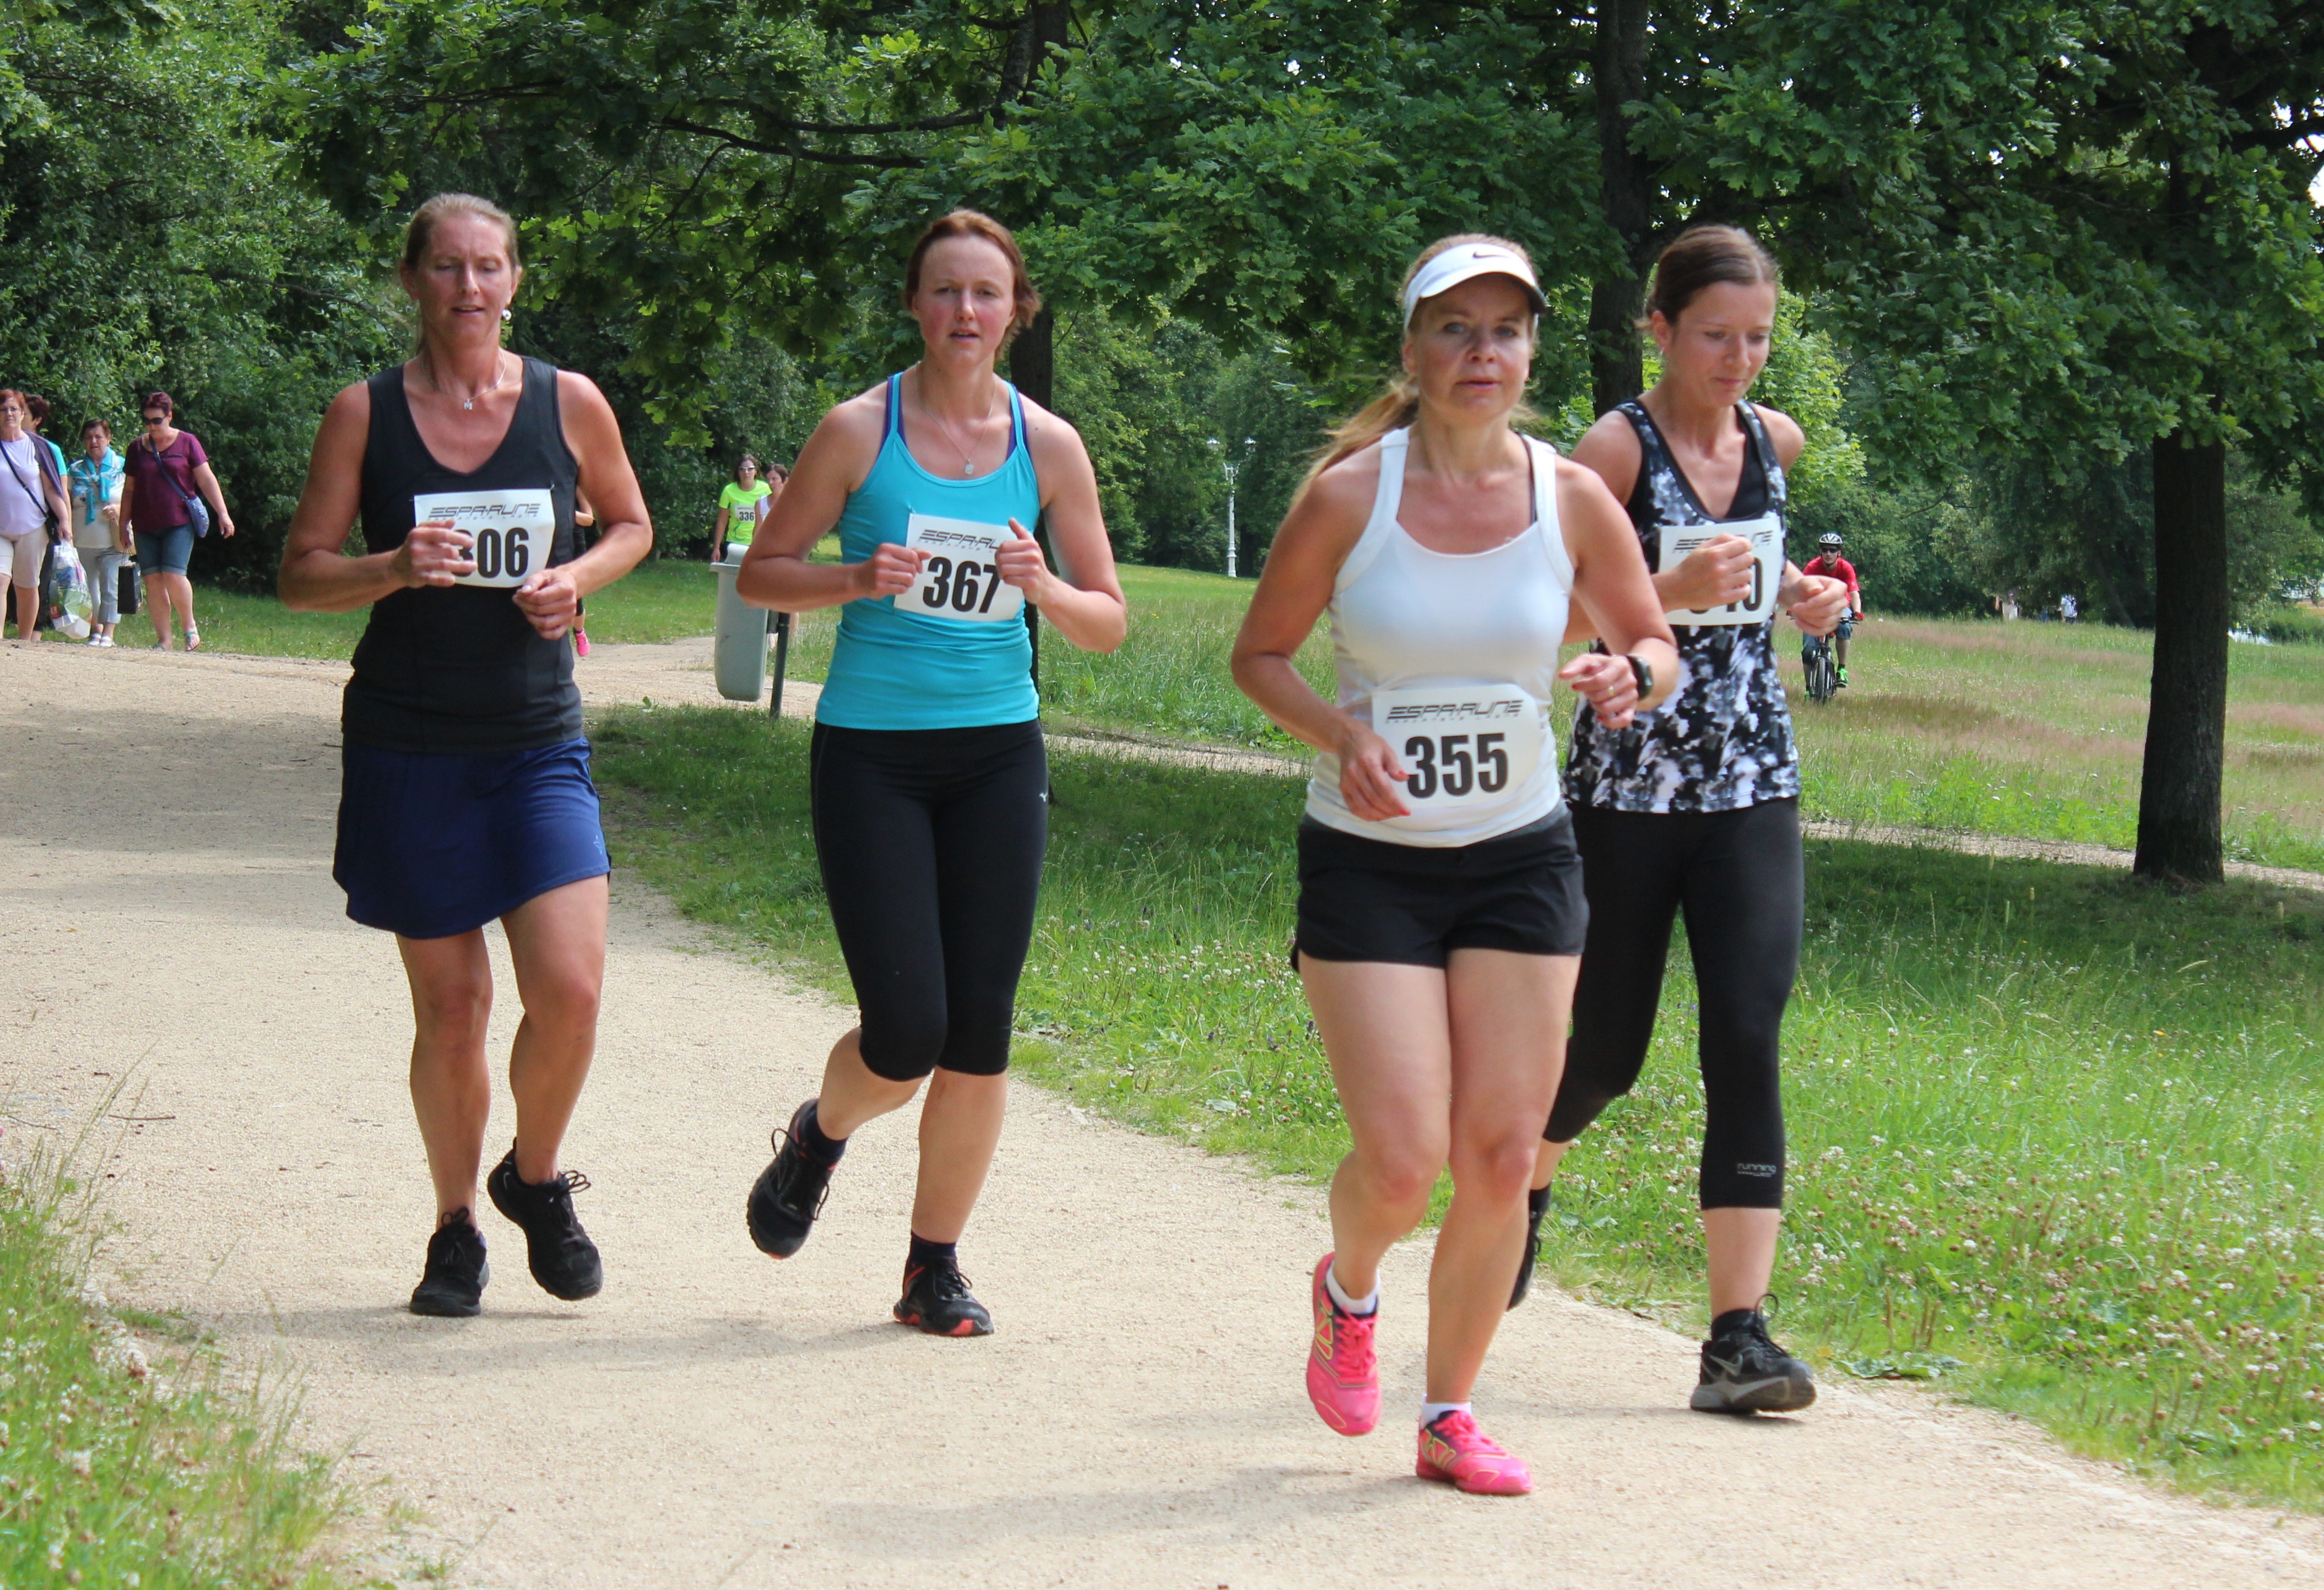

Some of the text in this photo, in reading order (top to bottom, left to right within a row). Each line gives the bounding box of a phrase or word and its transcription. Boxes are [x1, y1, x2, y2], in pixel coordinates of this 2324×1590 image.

[739, 511, 755, 522] 336
[922, 556, 1001, 614] 367
[1405, 732, 1509, 799] 355
